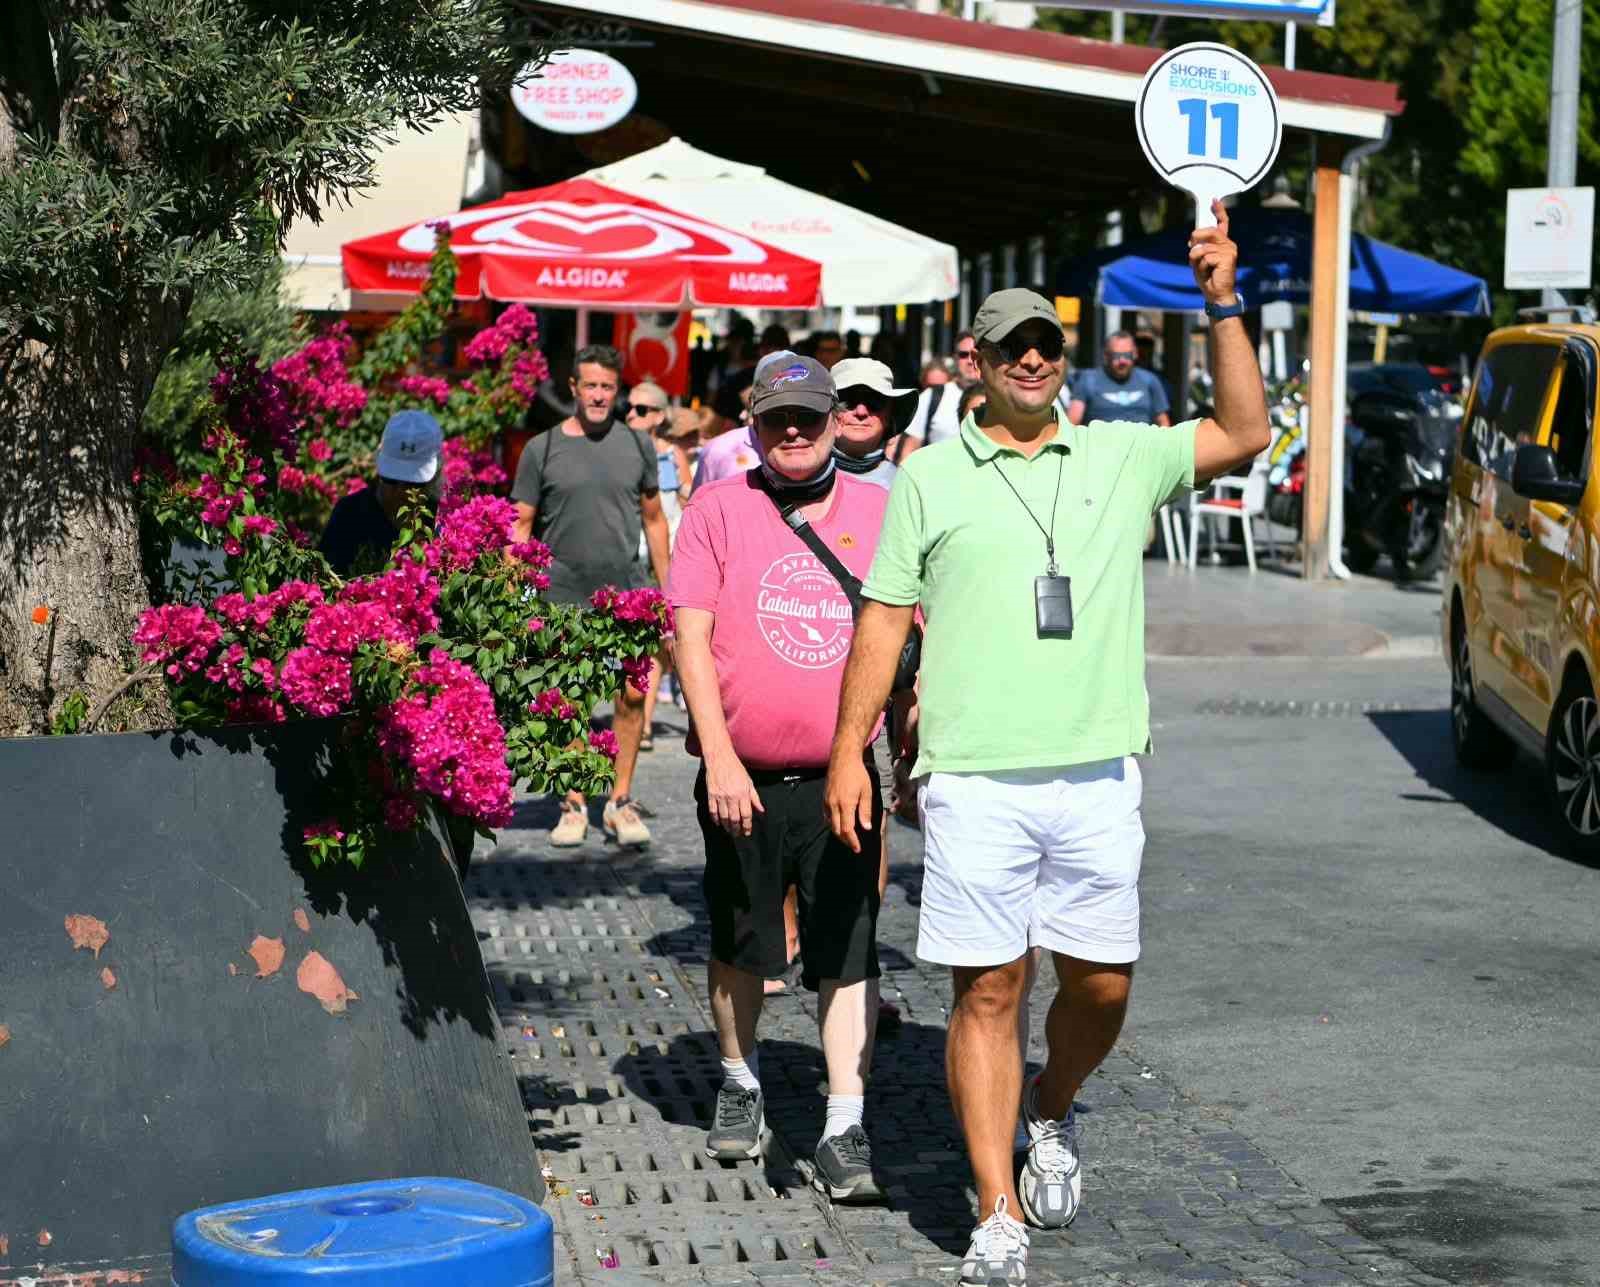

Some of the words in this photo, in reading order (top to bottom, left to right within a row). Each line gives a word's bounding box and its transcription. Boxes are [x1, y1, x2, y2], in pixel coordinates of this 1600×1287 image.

[540, 64, 609, 80] ORNER
[1169, 63, 1217, 80] SHORE
[523, 86, 569, 104] FREE
[575, 86, 625, 105] SHOP
[1169, 76, 1257, 97] EXCURSIONS
[1178, 98, 1239, 160] 11
[536, 267, 628, 289] ALGIDA
[728, 273, 789, 292] ALGIDA
[782, 559, 820, 574] AVAL
[757, 589, 817, 619] Catalina
[819, 598, 852, 619] Islan
[769, 629, 849, 662] CALIFORNIA
